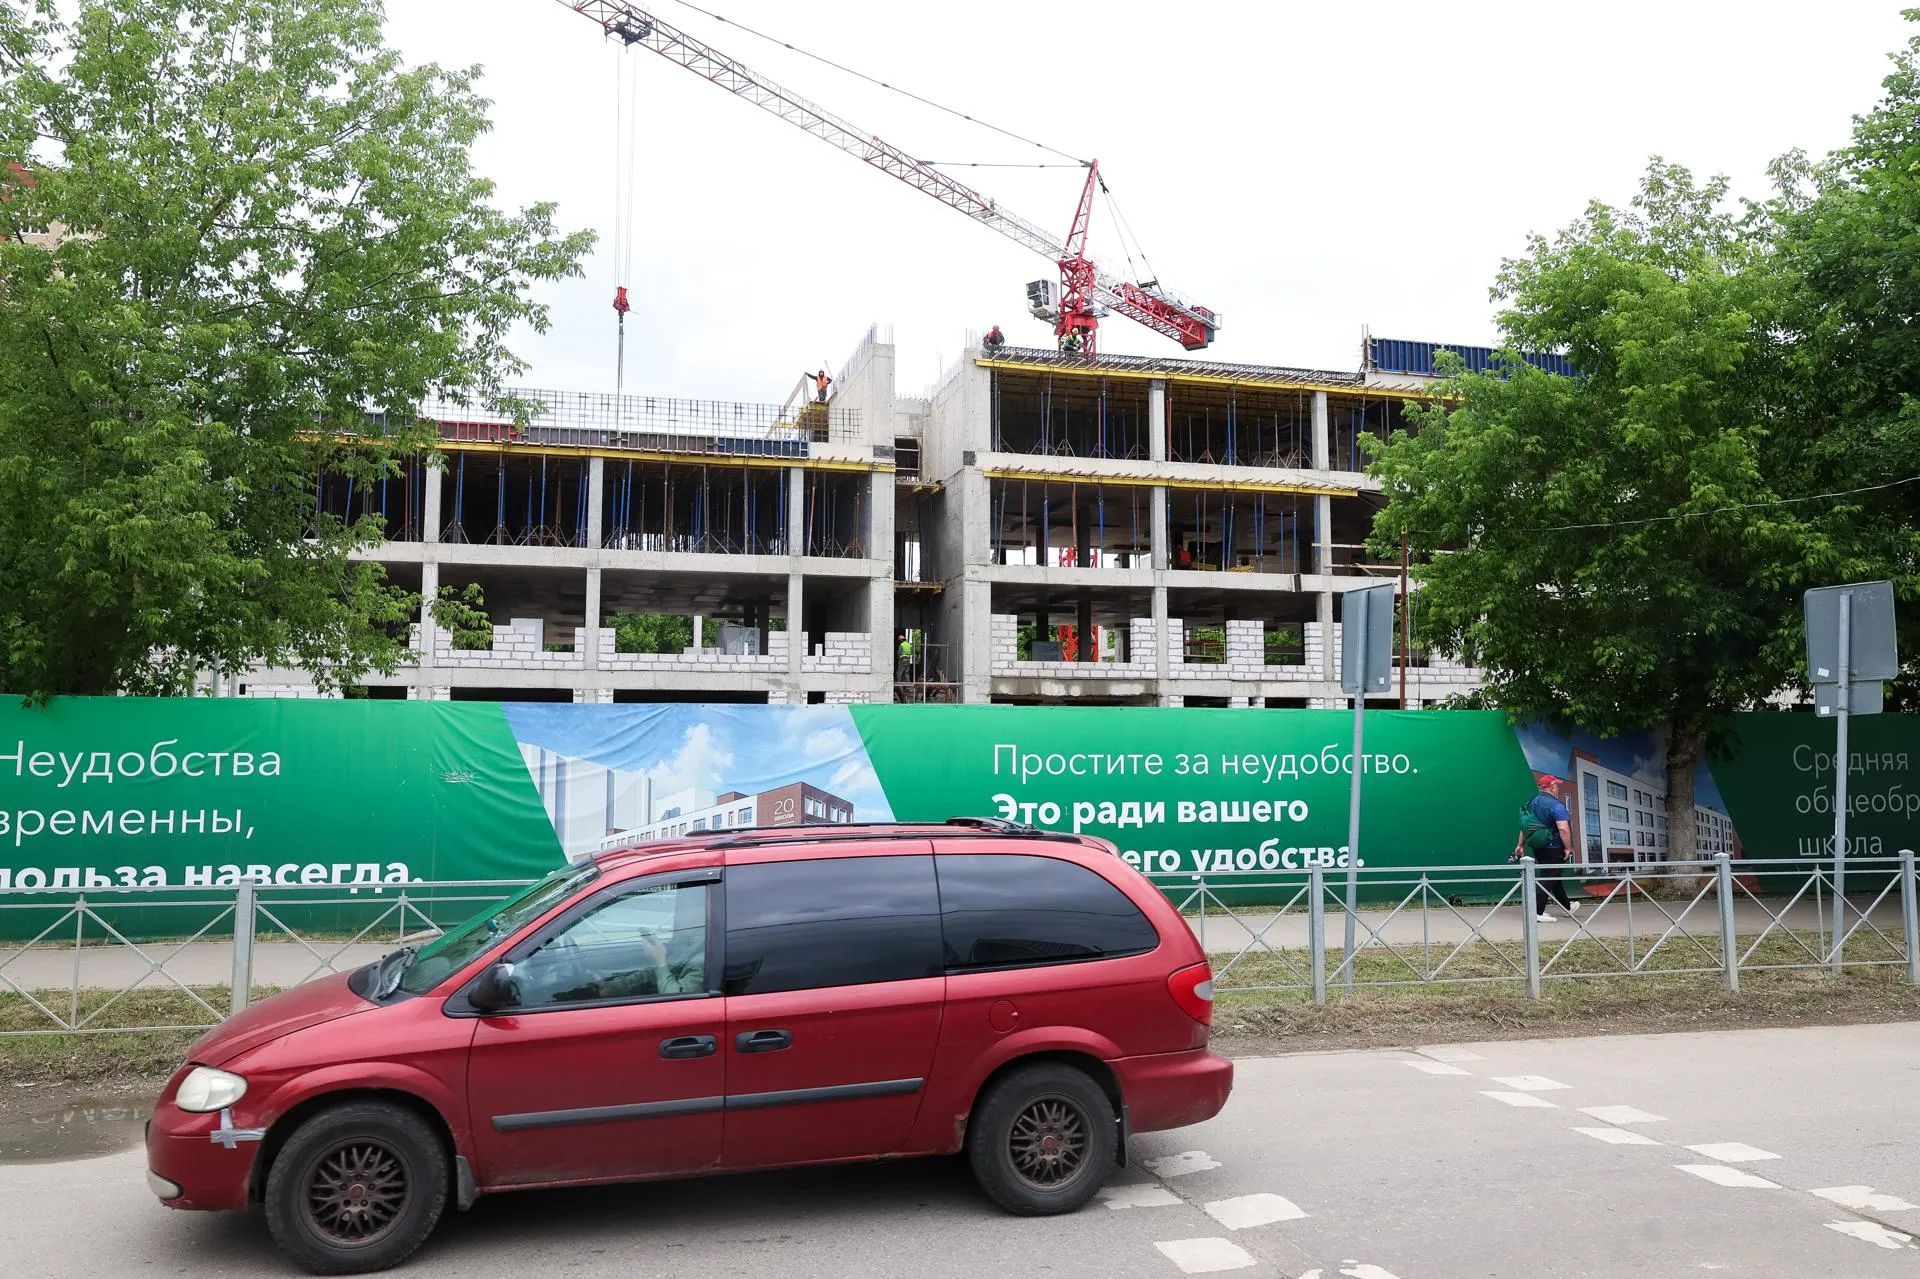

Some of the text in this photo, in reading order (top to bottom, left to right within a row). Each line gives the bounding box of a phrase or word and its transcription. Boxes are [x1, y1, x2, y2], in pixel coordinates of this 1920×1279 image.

[993, 742, 1418, 785] Простите за неудобство.
[774, 798, 794, 815] 20
[991, 793, 1309, 834] Это ради вашего
[184, 862, 424, 894] навсегда.
[1191, 837, 1365, 881] удобства.
